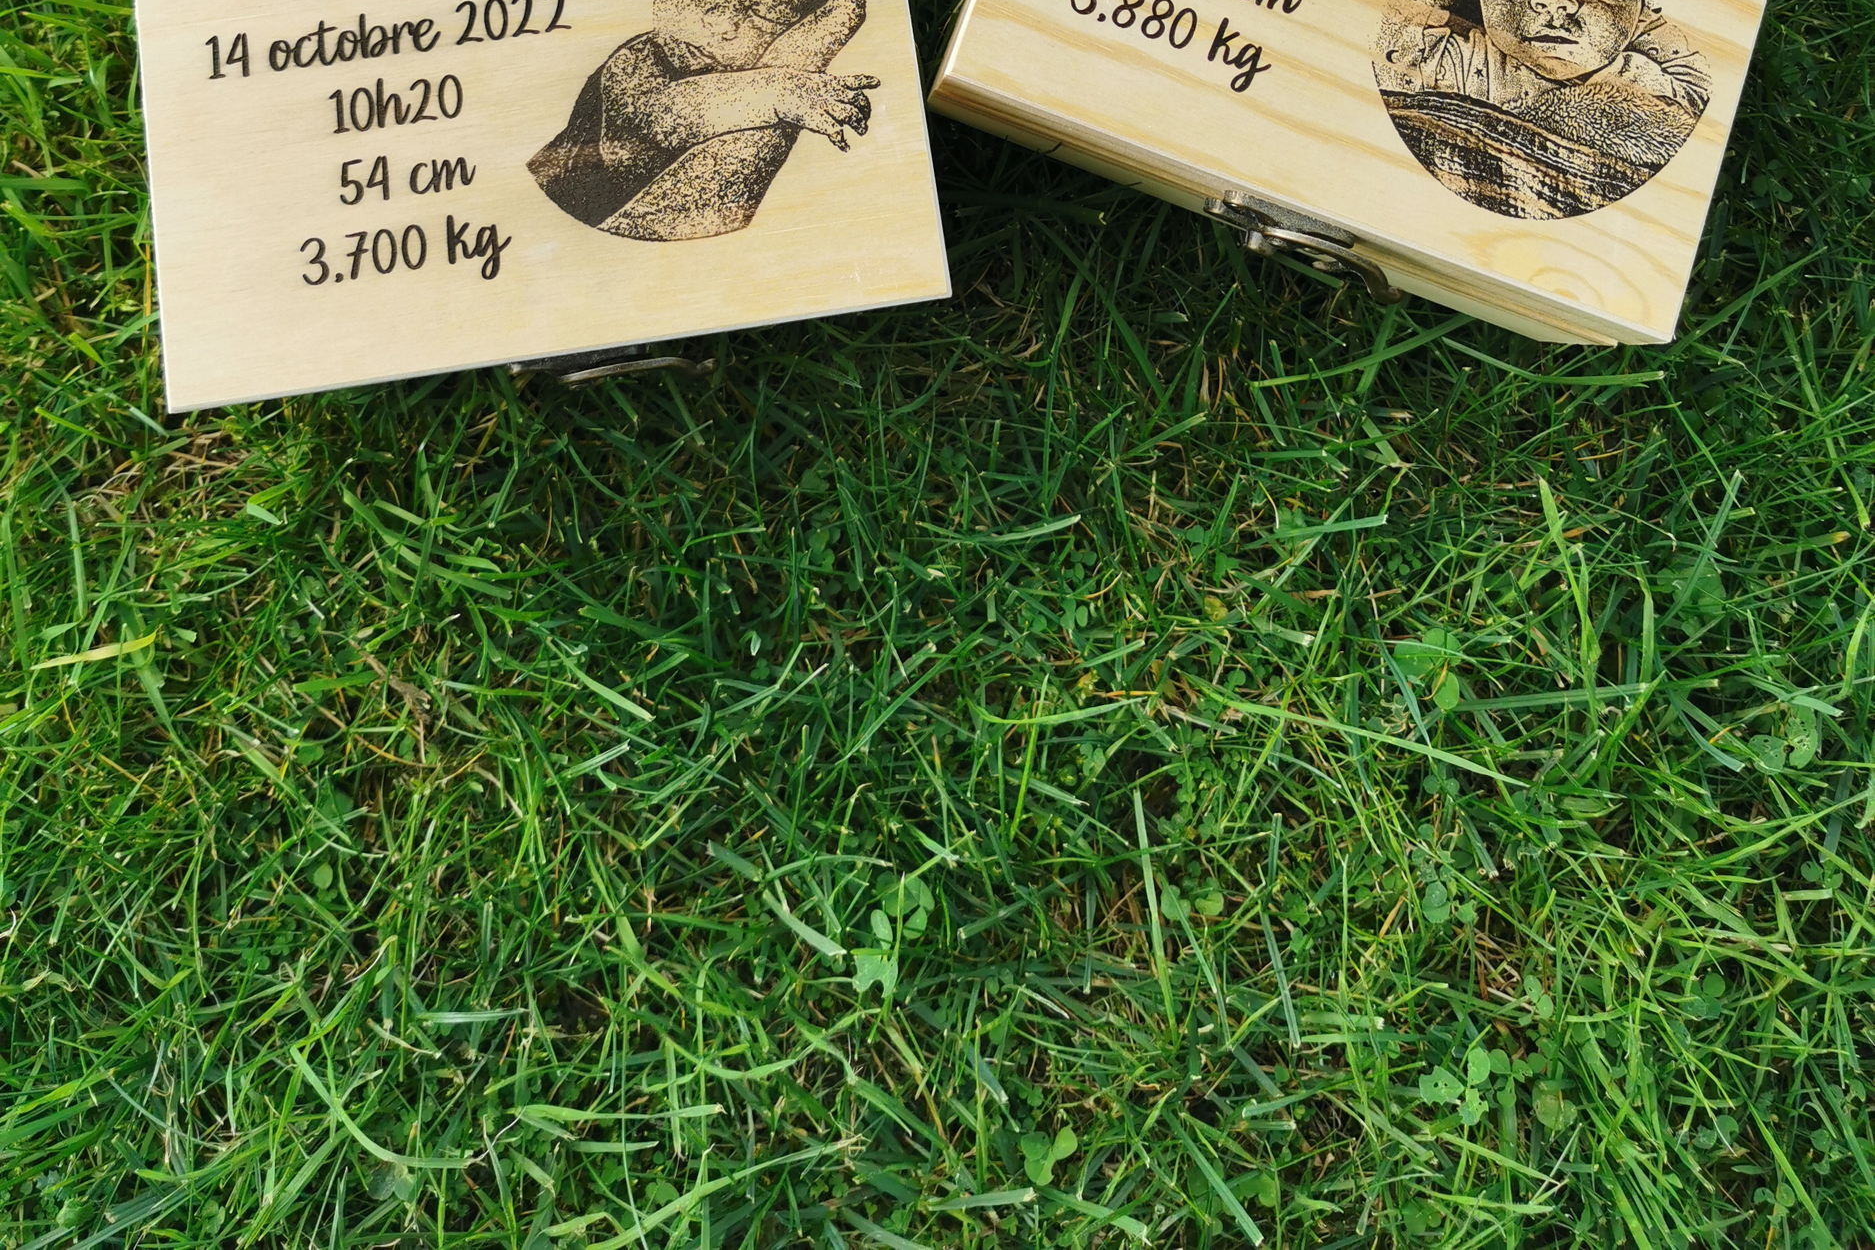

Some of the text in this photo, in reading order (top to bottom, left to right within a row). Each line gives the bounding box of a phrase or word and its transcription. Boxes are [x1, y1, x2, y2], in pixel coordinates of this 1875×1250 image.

[205, 32, 250, 80] 14
[268, 13, 441, 72] octobre
[328, 74, 463, 134] 10h20
[339, 155, 476, 206] 54 cm
[299, 224, 427, 286] 3.700
